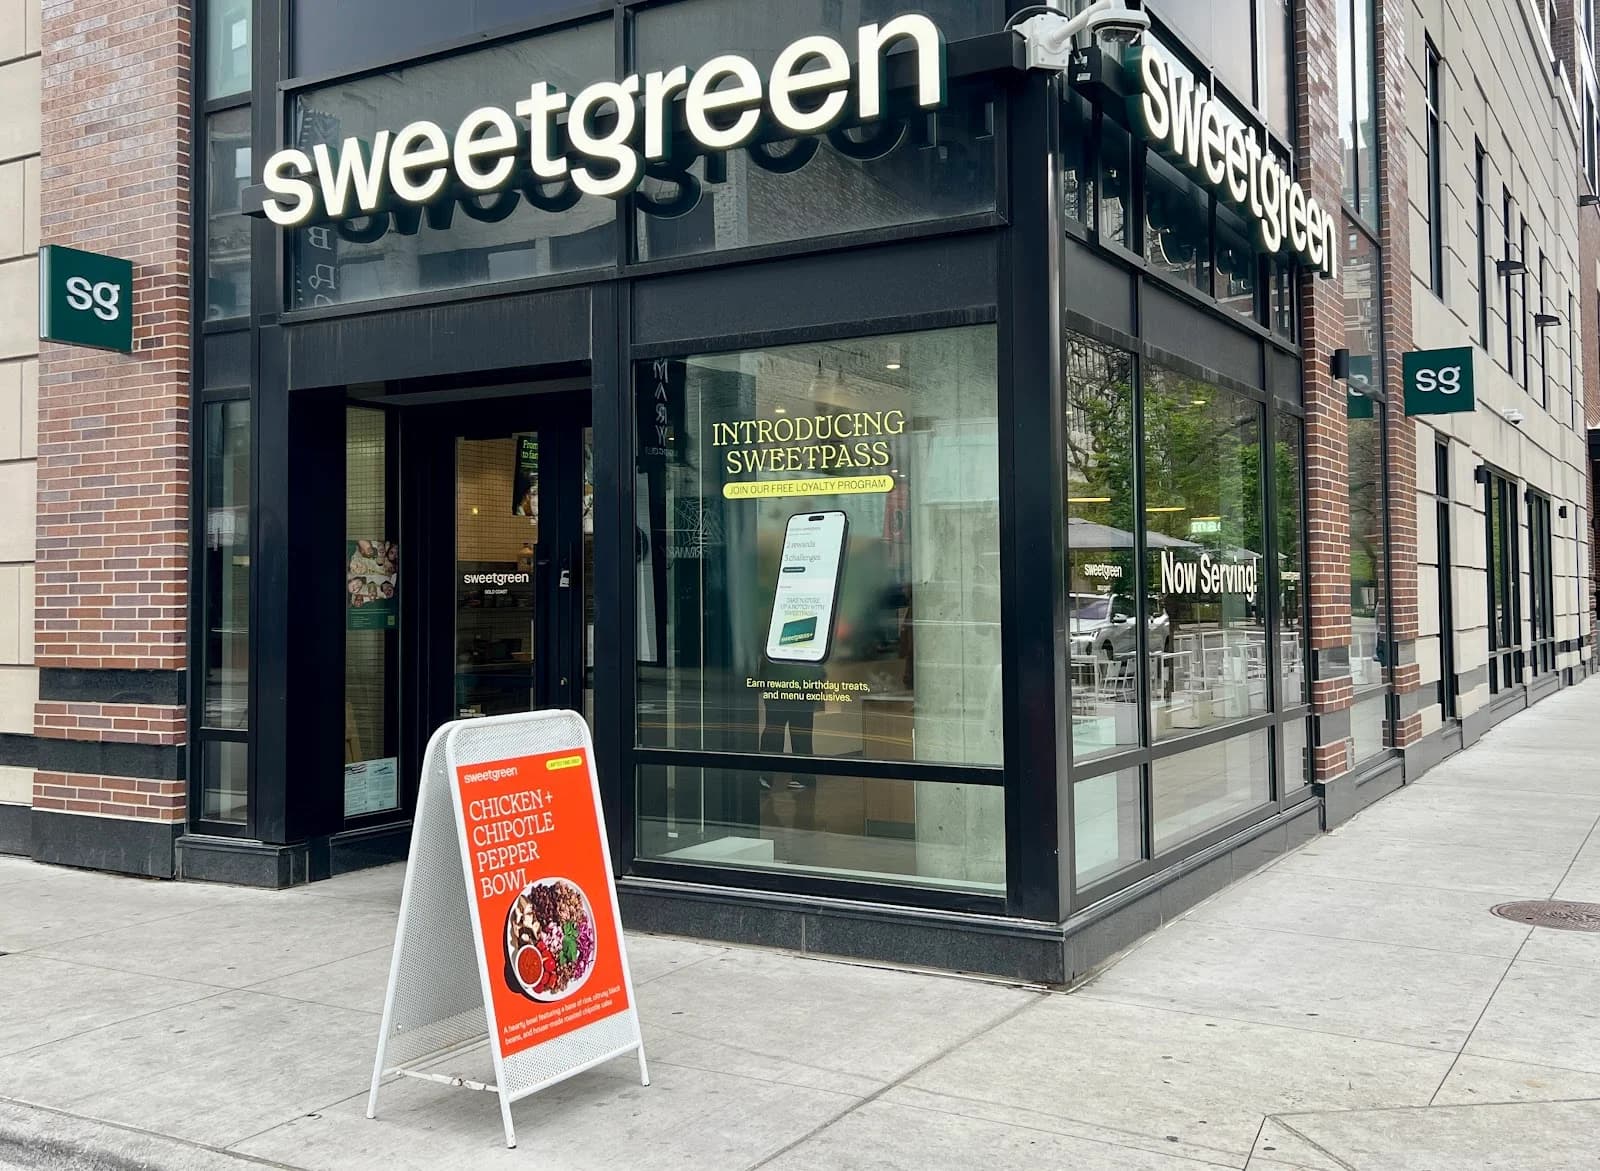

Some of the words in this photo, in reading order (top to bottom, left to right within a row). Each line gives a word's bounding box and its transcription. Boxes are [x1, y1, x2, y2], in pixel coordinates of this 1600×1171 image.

[261, 14, 941, 226] sweetgreen
[1141, 45, 1337, 279] sweetgreen
[66, 276, 121, 321] sg
[1415, 365, 1462, 395] sg
[712, 409, 906, 447] INTRODUCING
[726, 441, 890, 474] SWEETPASS
[729, 485, 749, 496] JOIN
[750, 484, 769, 495] OUR
[771, 483, 793, 493] FREE
[796, 480, 836, 492] LOYALTY
[837, 479, 887, 491] PROGRAM
[463, 572, 529, 586] sweetgreen
[1084, 563, 1122, 580] sweetgreen
[1161, 551, 1197, 594] Now
[1200, 553, 1258, 602] Serving!
[746, 677, 765, 688] Earn
[767, 678, 802, 691] rewards,
[803, 679, 840, 693] birthday
[841, 681, 871, 693] treats,
[763, 690, 779, 700] and
[780, 692, 805, 701] menu
[806, 692, 853, 703] exclusives.
[464, 766, 518, 784] sweetgreen
[469, 788, 544, 822] CHICKEN
[473, 811, 555, 847] CHIPOTLE
[477, 840, 540, 873] PEPPER
[480, 868, 534, 900] BOWL
